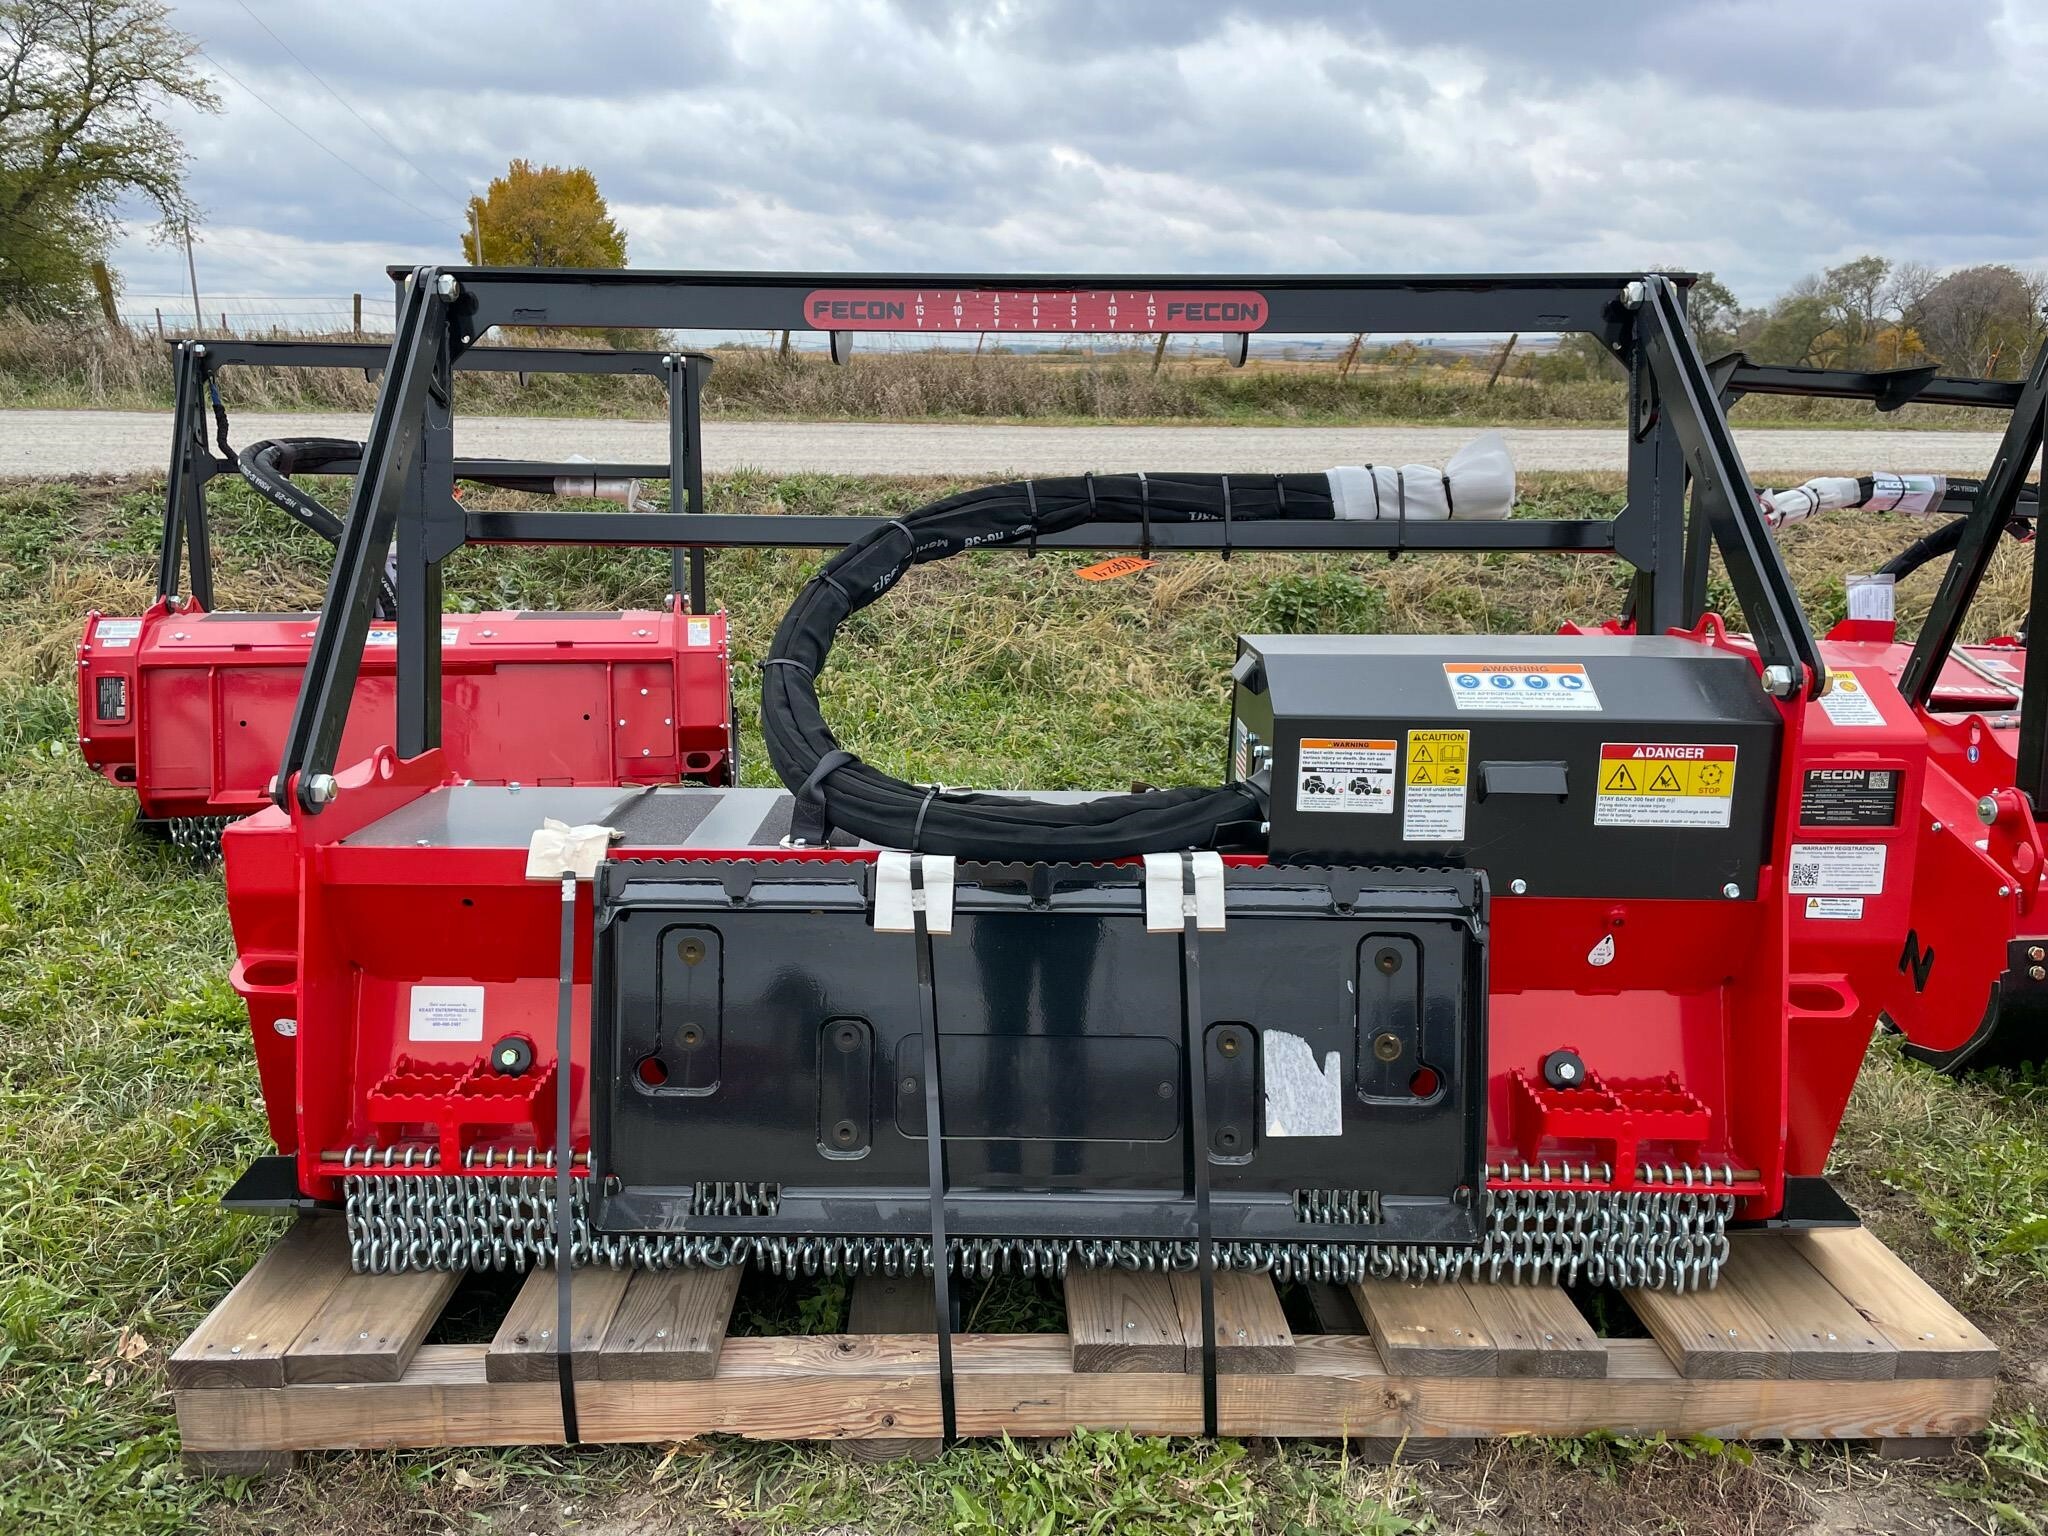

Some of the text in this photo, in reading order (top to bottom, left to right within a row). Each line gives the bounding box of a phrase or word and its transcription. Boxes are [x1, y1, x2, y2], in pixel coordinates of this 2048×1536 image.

[813, 301, 1259, 321] FECON 15 10 5 0 5 10 15 FECON
[1422, 733, 1464, 741] CAUTION
[1645, 748, 1704, 759] DANGER
[1810, 770, 1865, 780] FECON
